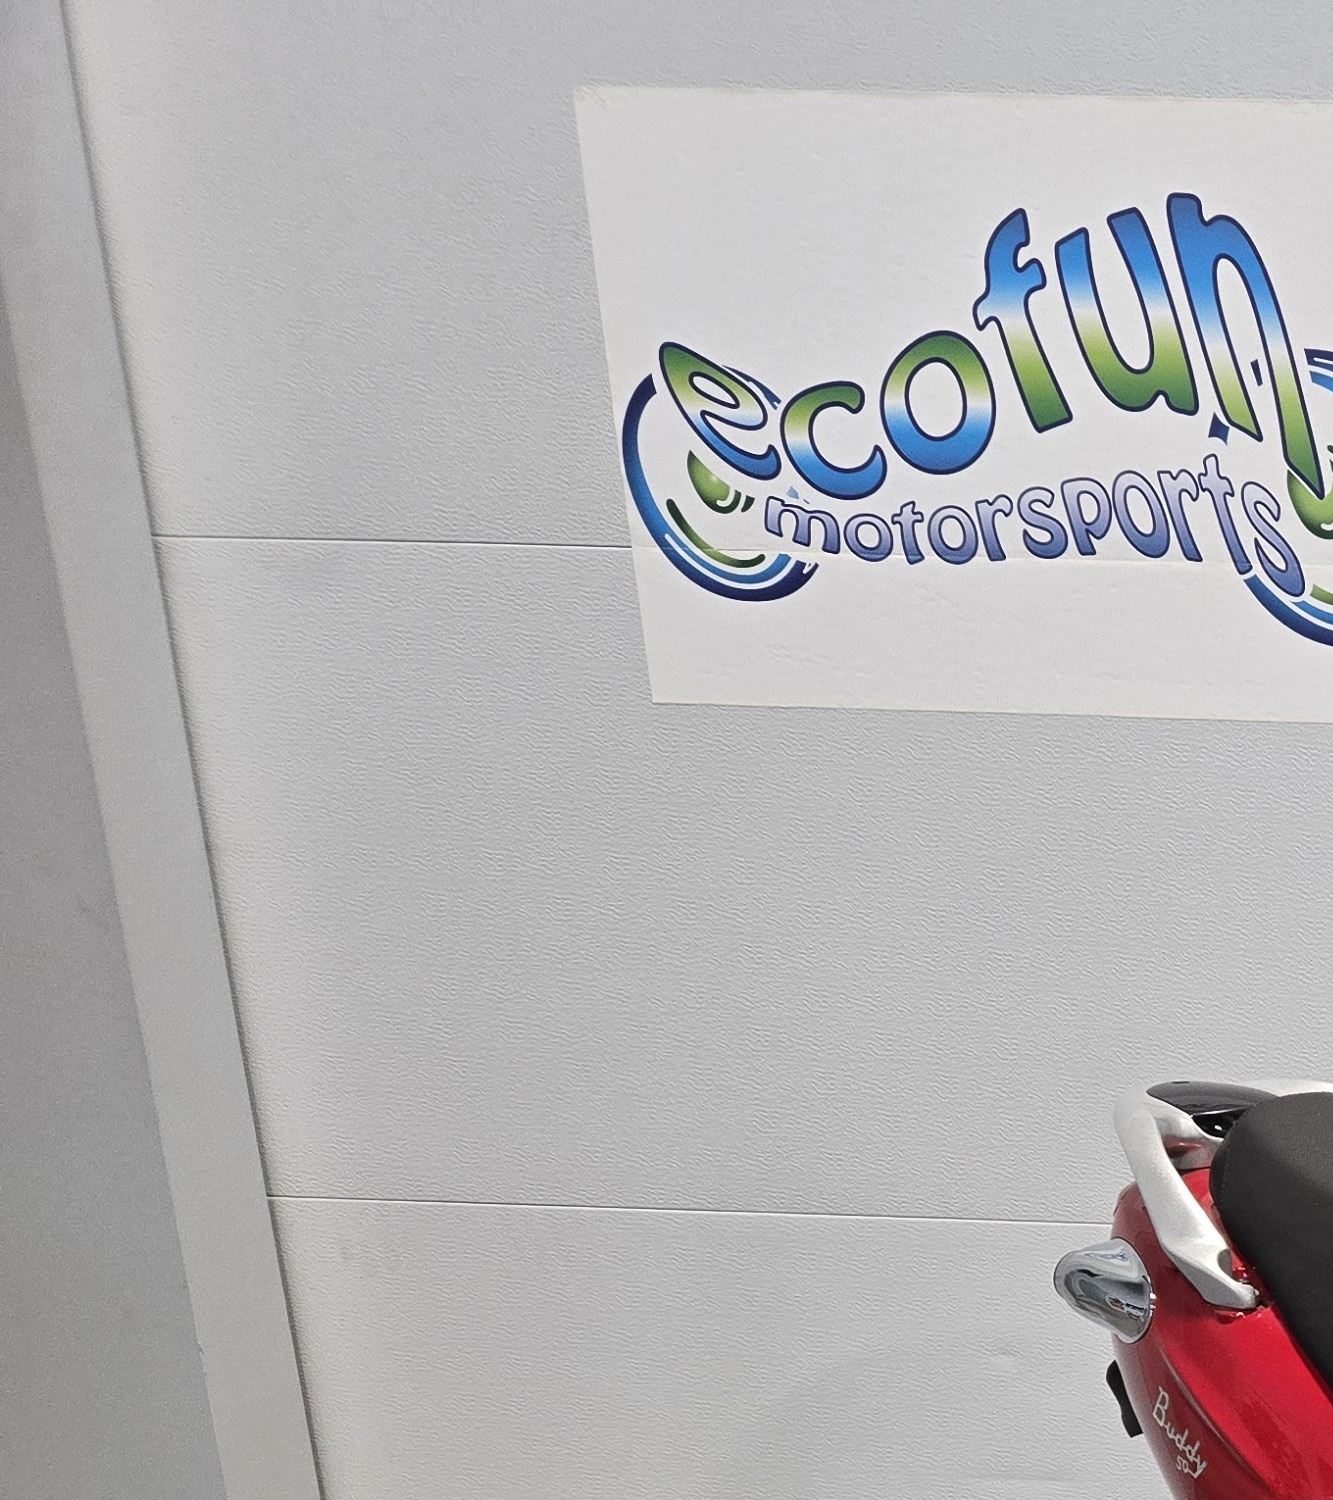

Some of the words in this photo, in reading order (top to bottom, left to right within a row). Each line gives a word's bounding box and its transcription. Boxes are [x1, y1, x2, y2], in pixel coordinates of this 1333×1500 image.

[659, 192, 1324, 501] ecofun
[765, 454, 1305, 599] motorsports
[1153, 1385, 1208, 1479] Buddy
